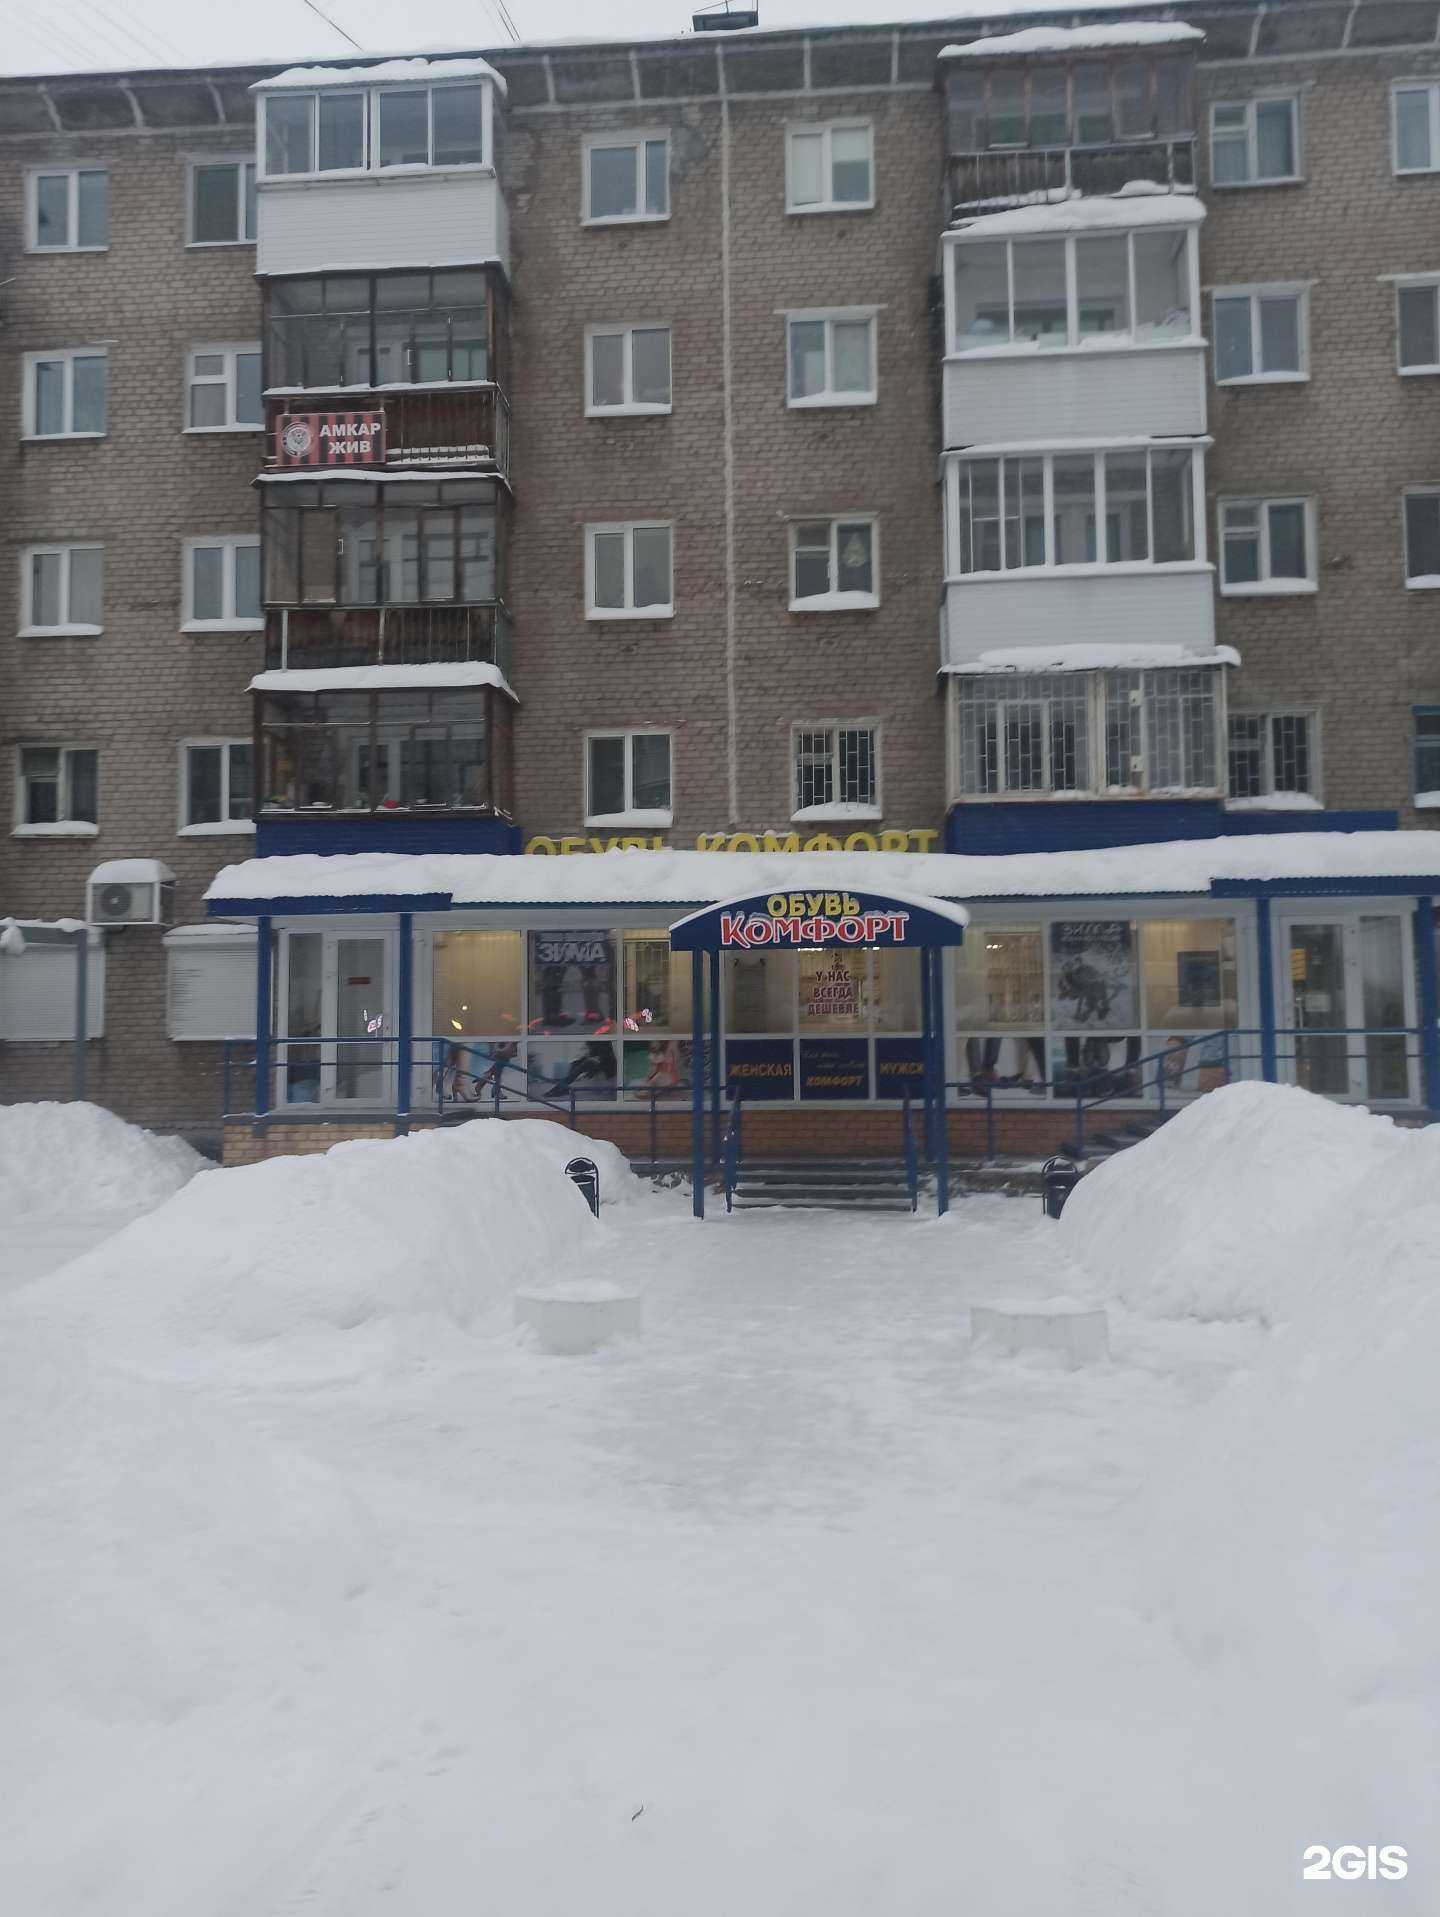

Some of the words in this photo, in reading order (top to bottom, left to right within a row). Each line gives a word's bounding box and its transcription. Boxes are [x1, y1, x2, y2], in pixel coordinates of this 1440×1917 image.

[320, 423, 381, 437] АМКАР
[328, 440, 371, 454] ЖИВ
[766, 893, 860, 917] ОБУВЬ
[720, 911, 909, 948] КОМФОРТ
[816, 971, 823, 982] У
[828, 970, 850, 982] НАС
[814, 987, 853, 999] ВСЕГДА
[807, 1003, 859, 1016] ДЕШЕВЛЕ
[729, 1063, 792, 1077] ЖЕНСКАЯ
[880, 1062, 924, 1075] МУЖСК
[806, 1075, 864, 1087] КОМФОРТ
